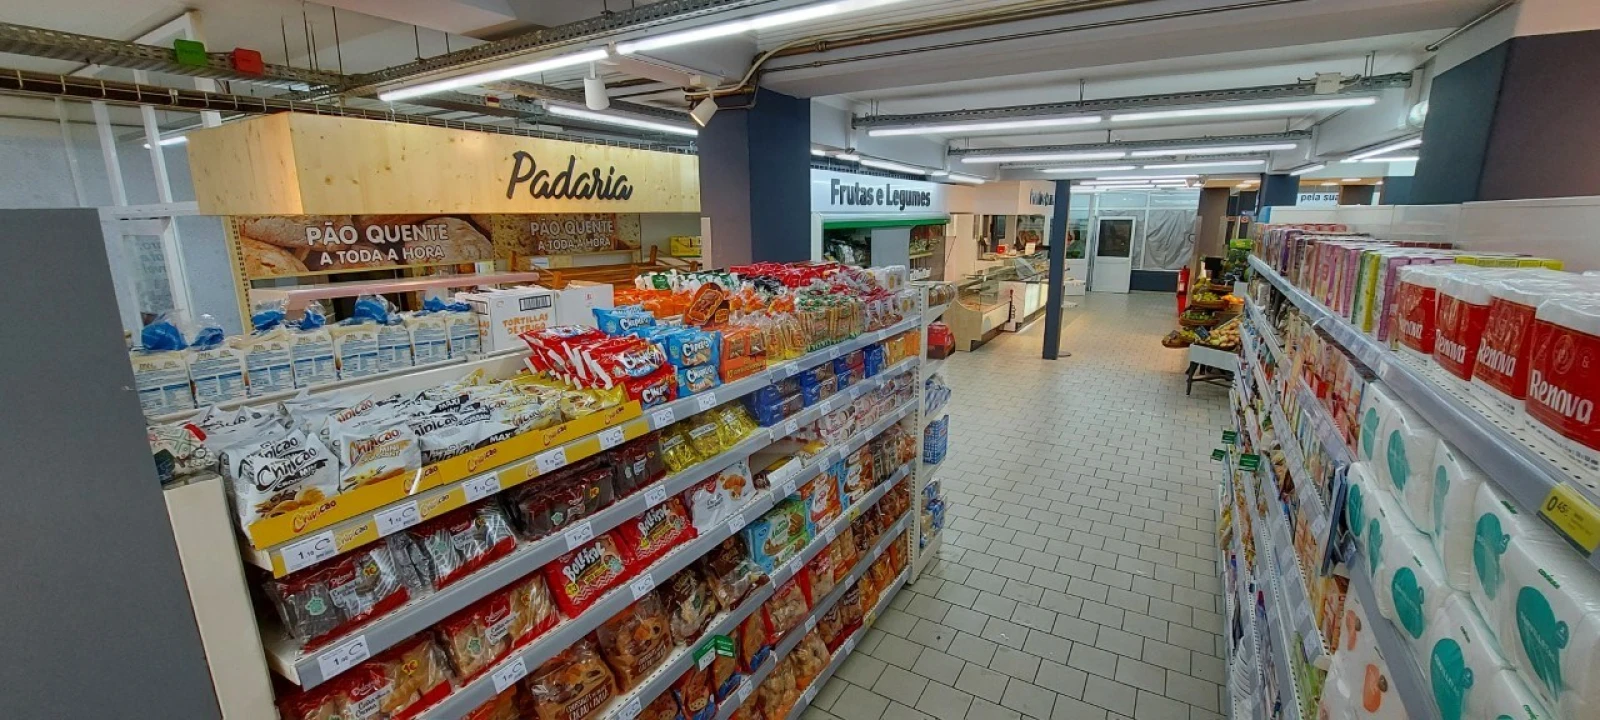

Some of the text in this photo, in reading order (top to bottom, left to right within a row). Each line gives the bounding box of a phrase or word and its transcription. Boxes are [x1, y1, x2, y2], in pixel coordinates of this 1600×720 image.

[506, 150, 633, 201] Padaria
[830, 178, 931, 211] Frutas e Legumes
[1300, 193, 1321, 202] pela
[305, 222, 449, 246] PÃO QUENTE
[530, 218, 613, 236] PÃO QUENTE
[319, 245, 445, 266] A TODA A HORA
[538, 236, 612, 251] A TODA A HORA
[502, 313, 549, 328] TORTILLAS
[1436, 329, 1466, 364] Renova
[1477, 338, 1517, 377] Renova
[1530, 370, 1594, 425] Renova
